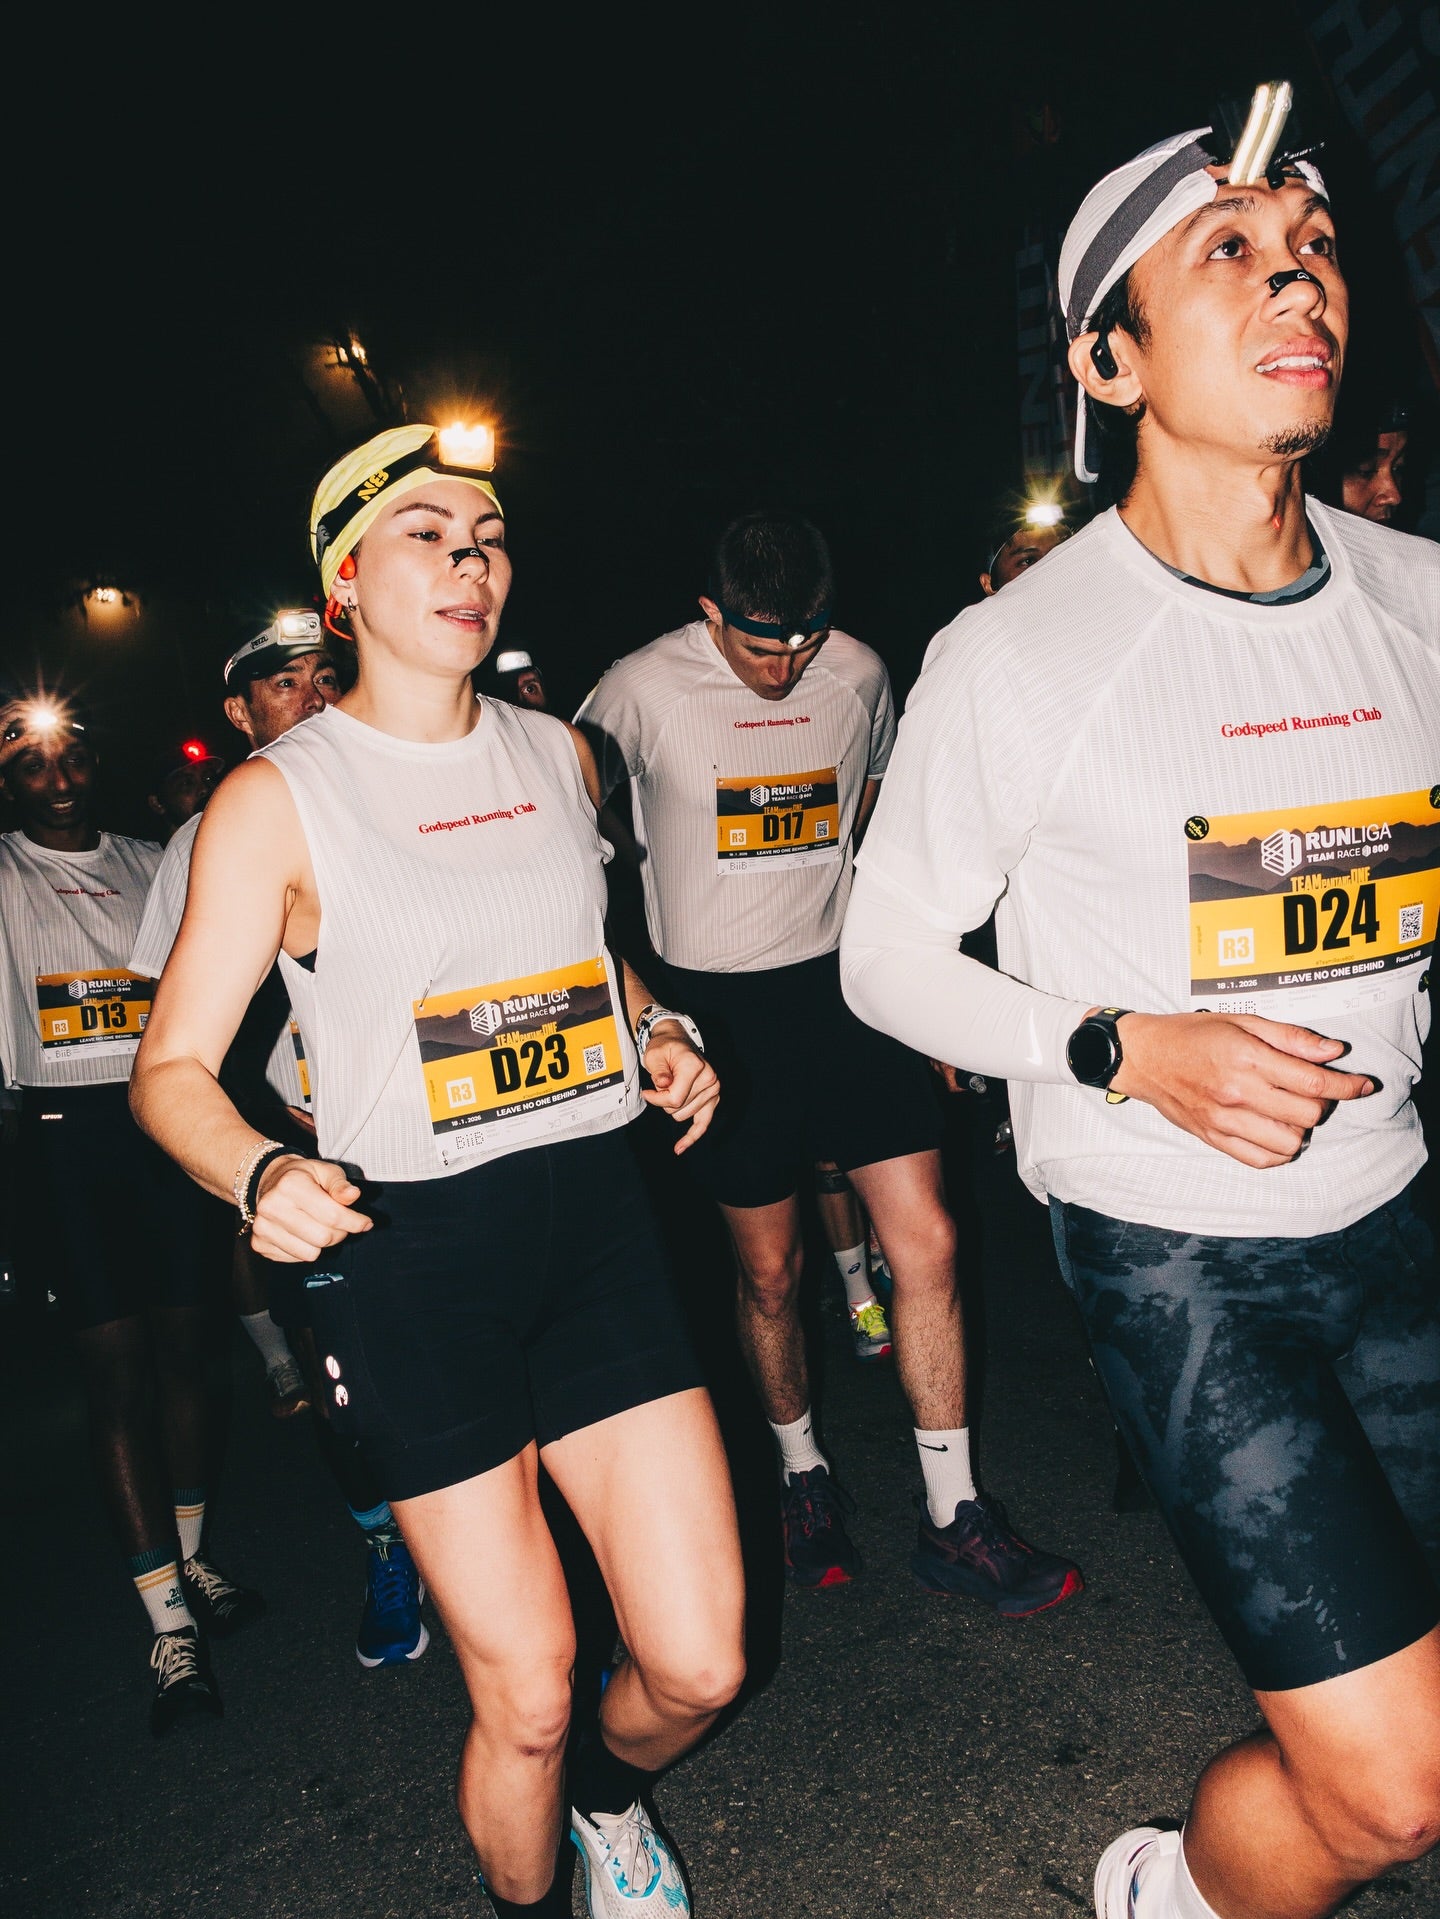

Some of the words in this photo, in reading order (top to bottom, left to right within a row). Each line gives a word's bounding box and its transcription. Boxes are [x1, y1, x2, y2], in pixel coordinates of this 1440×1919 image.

[735, 720, 765, 729] Godspeed
[1221, 719, 1288, 738] Godspeed
[1292, 713, 1351, 730] Running
[1353, 707, 1382, 722] Club
[772, 784, 814, 796] RUNLIGA
[419, 817, 471, 834] Godspeed
[472, 809, 515, 824] Running
[514, 803, 537, 815] Club
[763, 812, 804, 842] D17
[732, 833, 745, 843] R3
[1306, 822, 1392, 851] RUNLIGA
[1307, 852, 1335, 863] TEAM
[1337, 848, 1361, 859] RACE
[1372, 844, 1389, 854] 800
[1291, 874, 1322, 893] TEAM
[1283, 883, 1380, 956] D24
[1223, 936, 1250, 960] R3
[89, 979, 132, 989] RUNLIGA
[1279, 974, 1313, 985] LEAVE
[1314, 970, 1330, 981] NO
[1331, 967, 1351, 978] ONE
[1352, 960, 1385, 974] BEHIND
[503, 988, 570, 1015] RUNLIGA
[55, 1023, 67, 1033] R3
[81, 1002, 127, 1030] D13
[506, 1014, 529, 1024] TEAM
[530, 1009, 549, 1019] RACE
[495, 1031, 520, 1047] TEAM
[490, 1034, 570, 1095] D23
[450, 1083, 473, 1103] R3
[496, 1105, 522, 1117] LEAVE
[523, 1102, 535, 1111] NO
[536, 1097, 551, 1108] ONE
[552, 1089, 577, 1103] BEHIND
